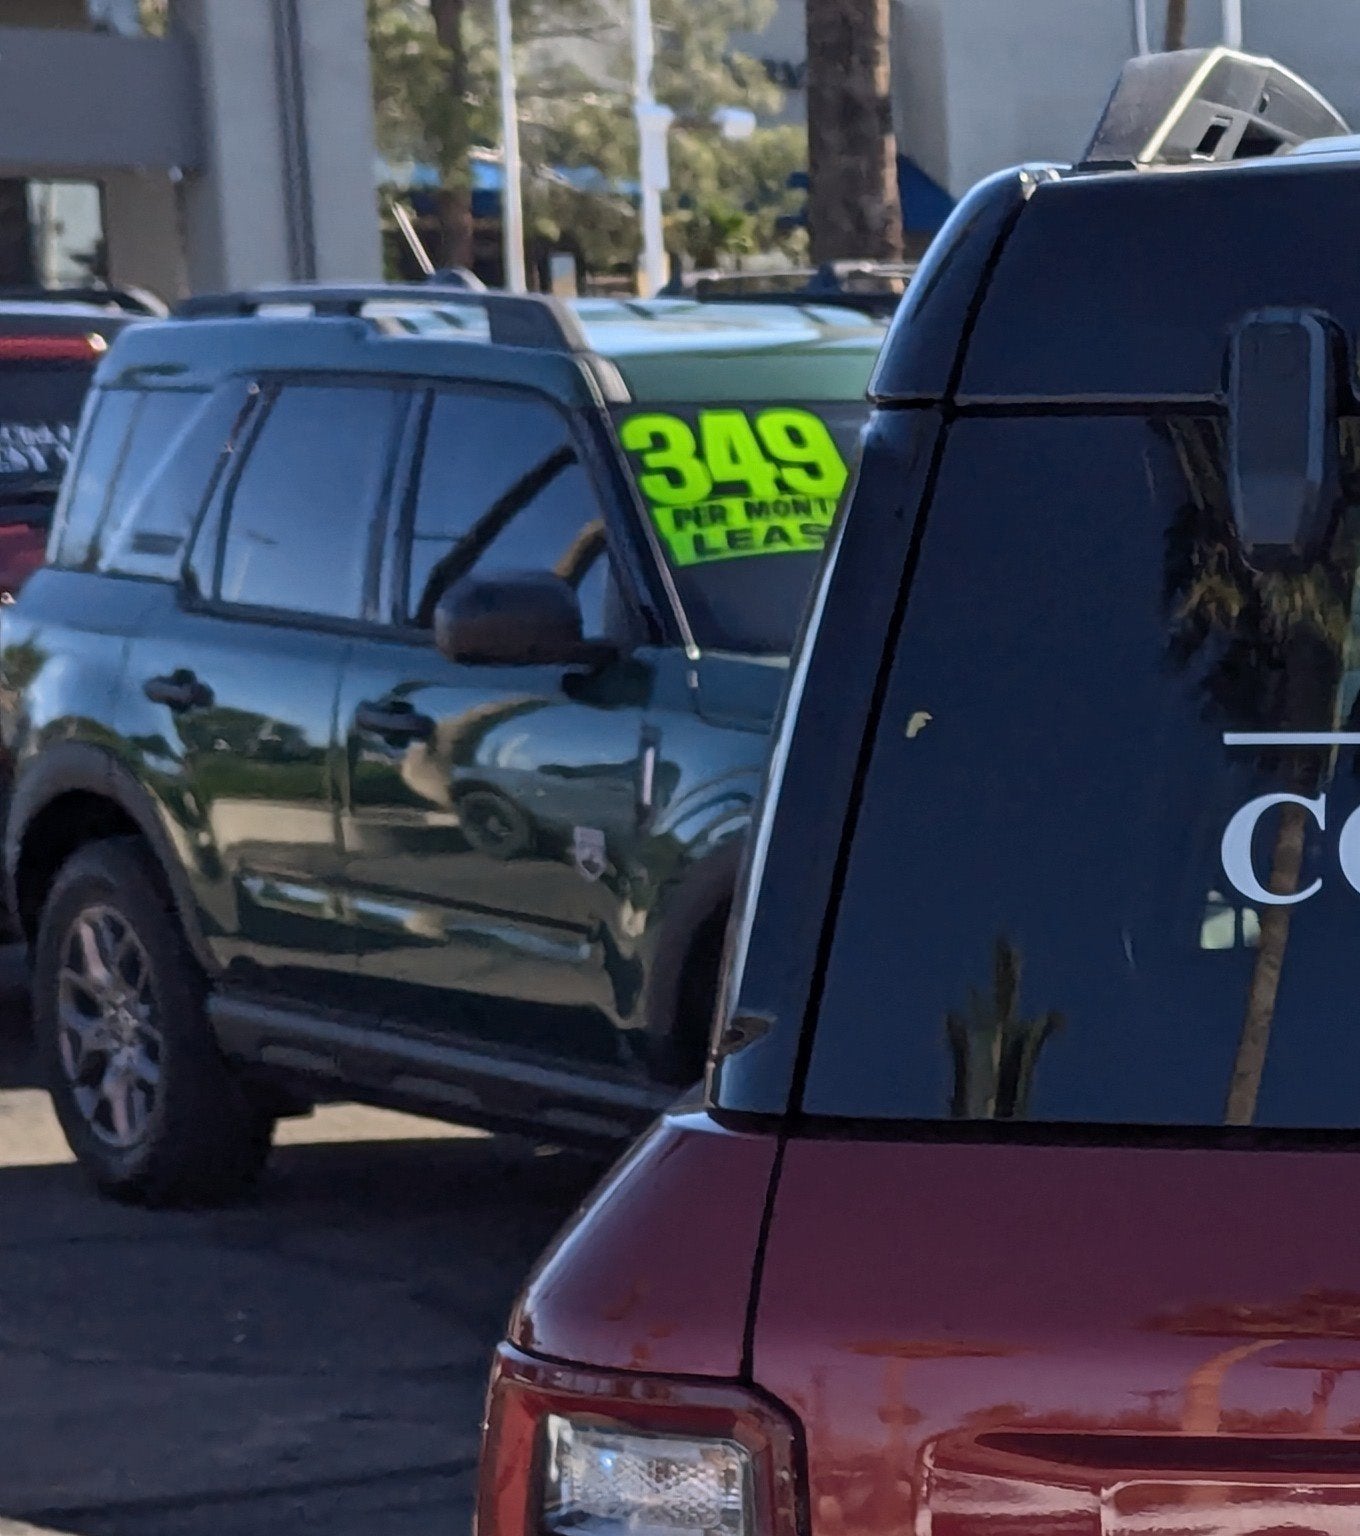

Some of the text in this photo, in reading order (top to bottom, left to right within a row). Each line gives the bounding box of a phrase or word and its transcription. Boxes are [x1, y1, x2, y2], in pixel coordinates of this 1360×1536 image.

[620, 408, 848, 505] 349
[744, 494, 833, 521] MONT
[693, 523, 833, 556] LEAS
